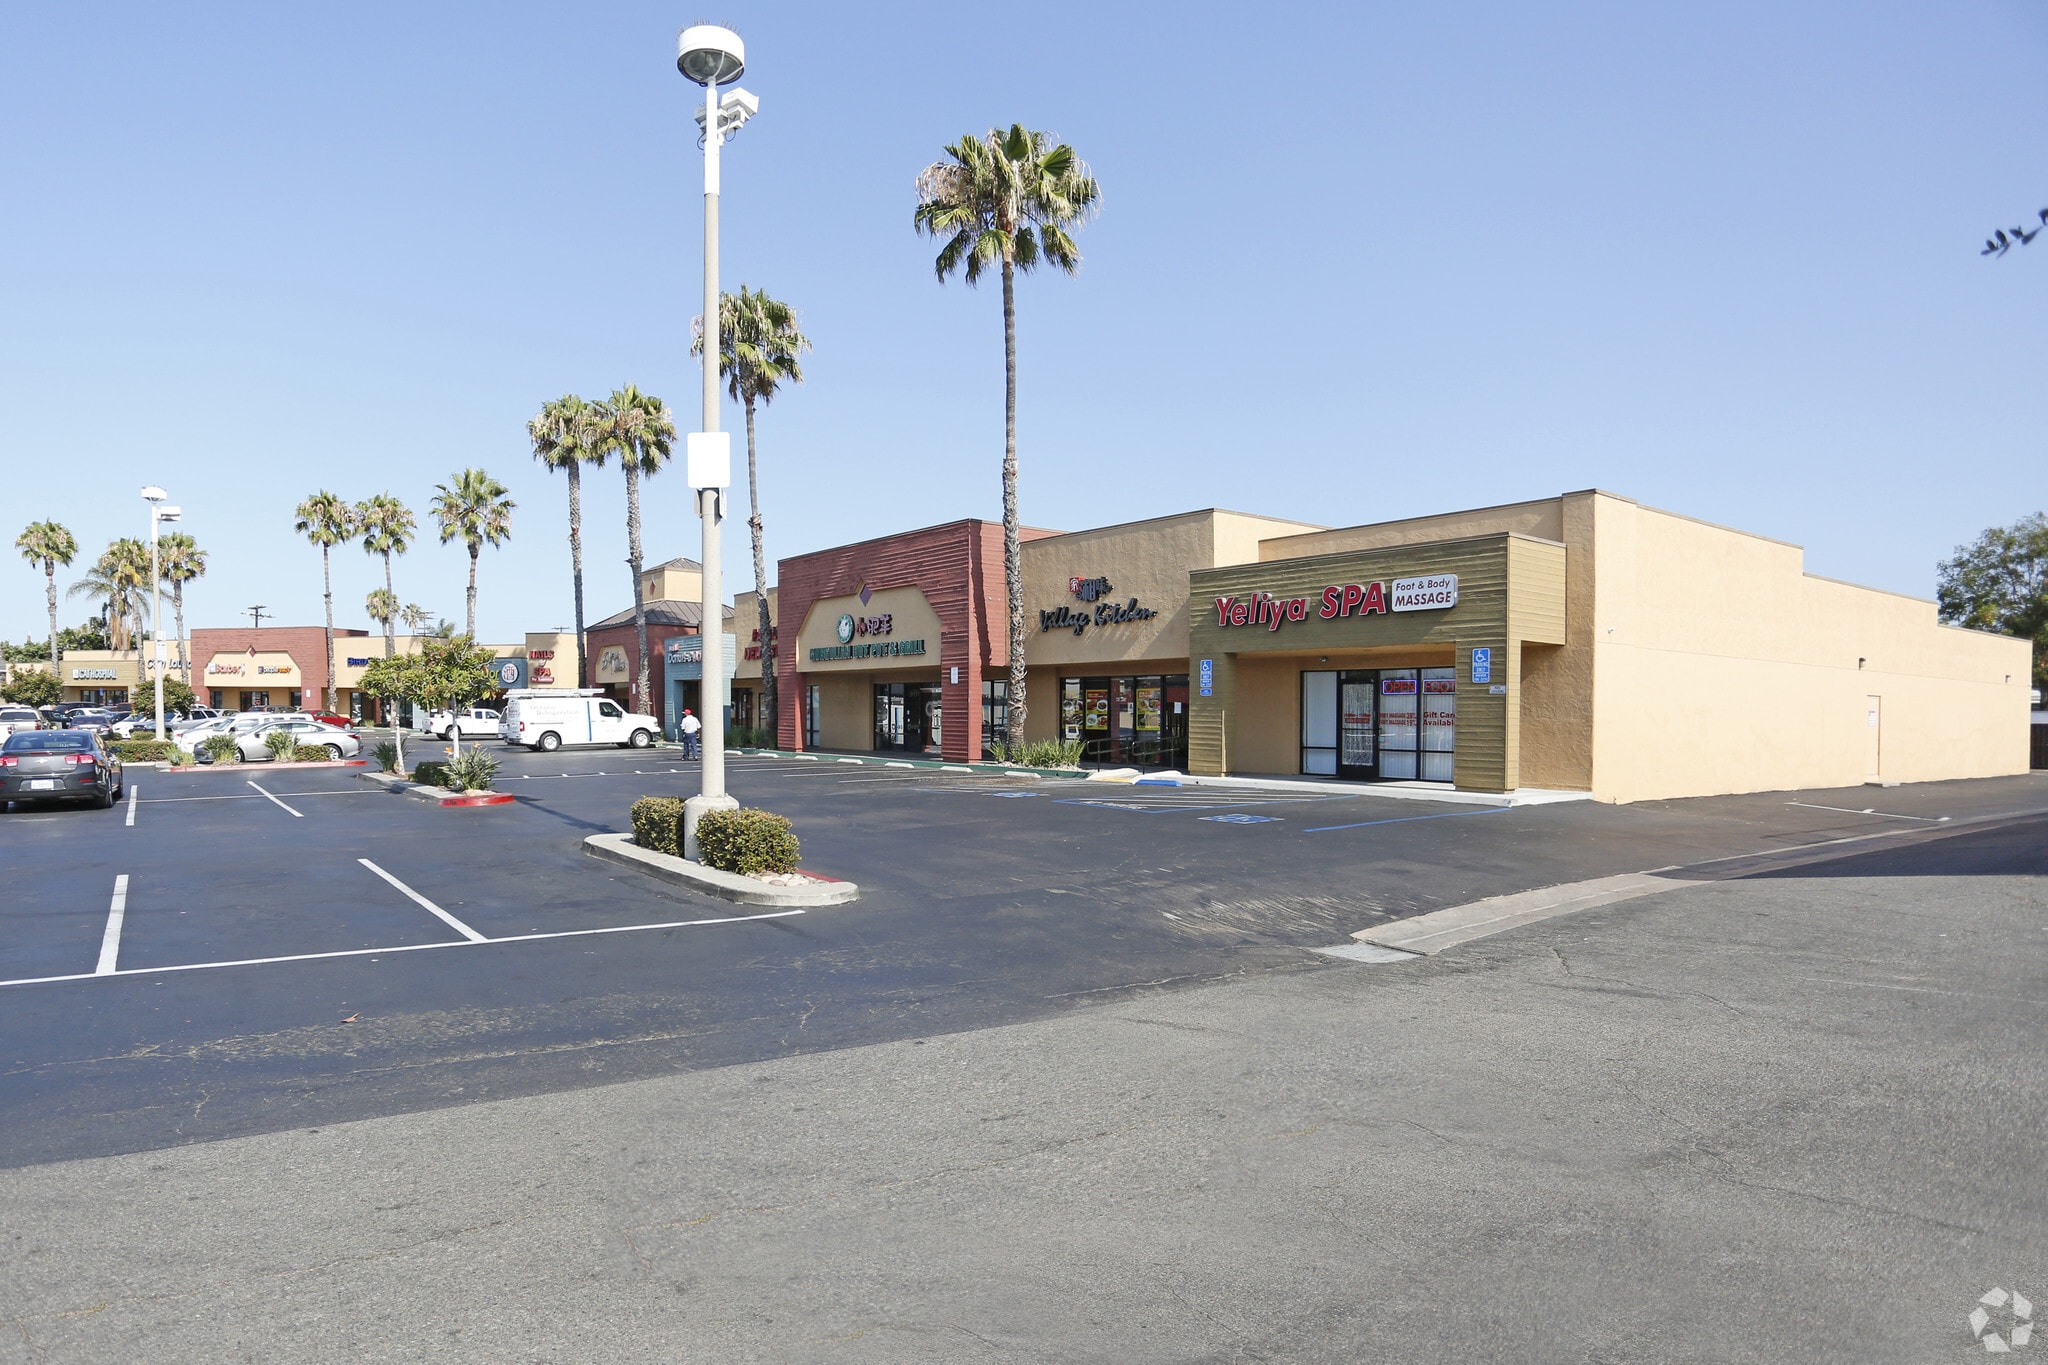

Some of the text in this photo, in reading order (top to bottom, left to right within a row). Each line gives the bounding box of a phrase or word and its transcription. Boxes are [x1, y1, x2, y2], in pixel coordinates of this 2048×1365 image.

[1395, 579, 1451, 592] Foot & Body
[1215, 581, 1387, 631] Yeliya SPA
[1394, 591, 1452, 607] MASSAGE
[1039, 597, 1158, 636] Village Kitchen
[529, 650, 555, 659] NAILS
[889, 641, 898, 656] &
[899, 639, 926, 655] GRILL
[534, 667, 551, 676] SPA
[1385, 681, 1415, 693] OPEN
